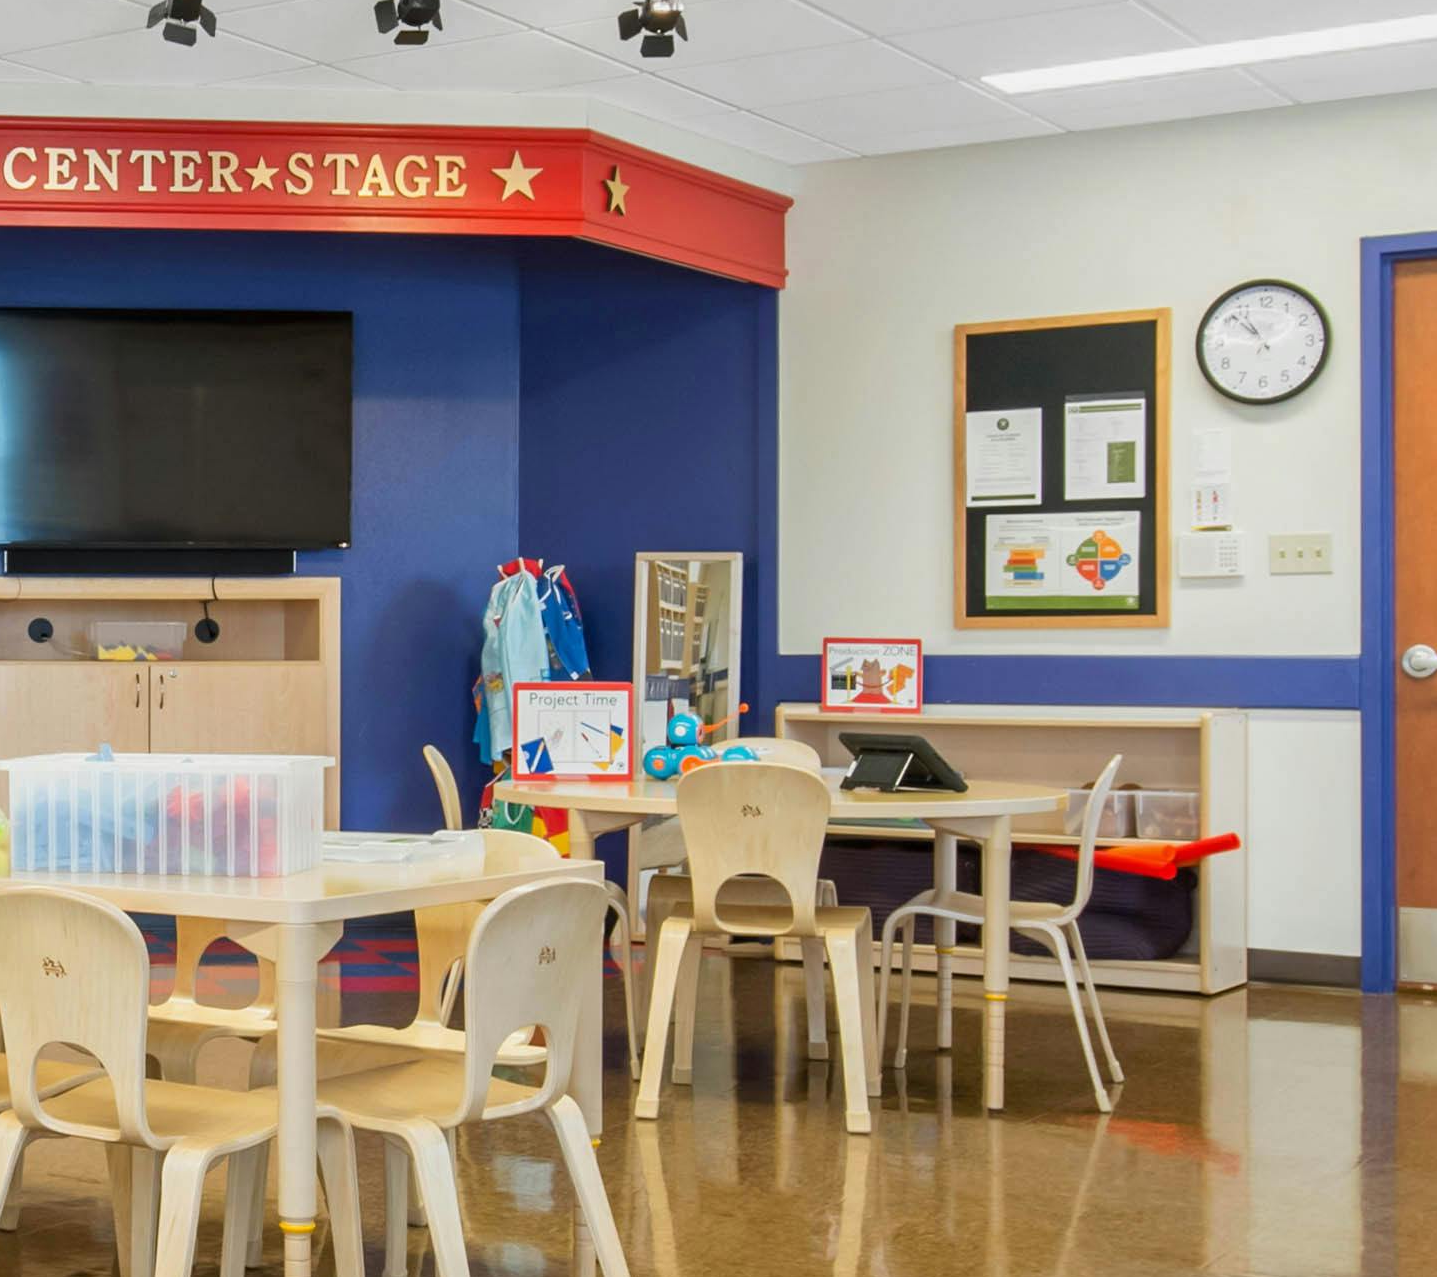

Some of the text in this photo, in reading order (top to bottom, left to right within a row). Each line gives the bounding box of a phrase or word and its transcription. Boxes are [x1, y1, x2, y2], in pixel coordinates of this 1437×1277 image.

[2, 146, 467, 200] CENTER STAGE
[528, 691, 618, 709] Project Time
